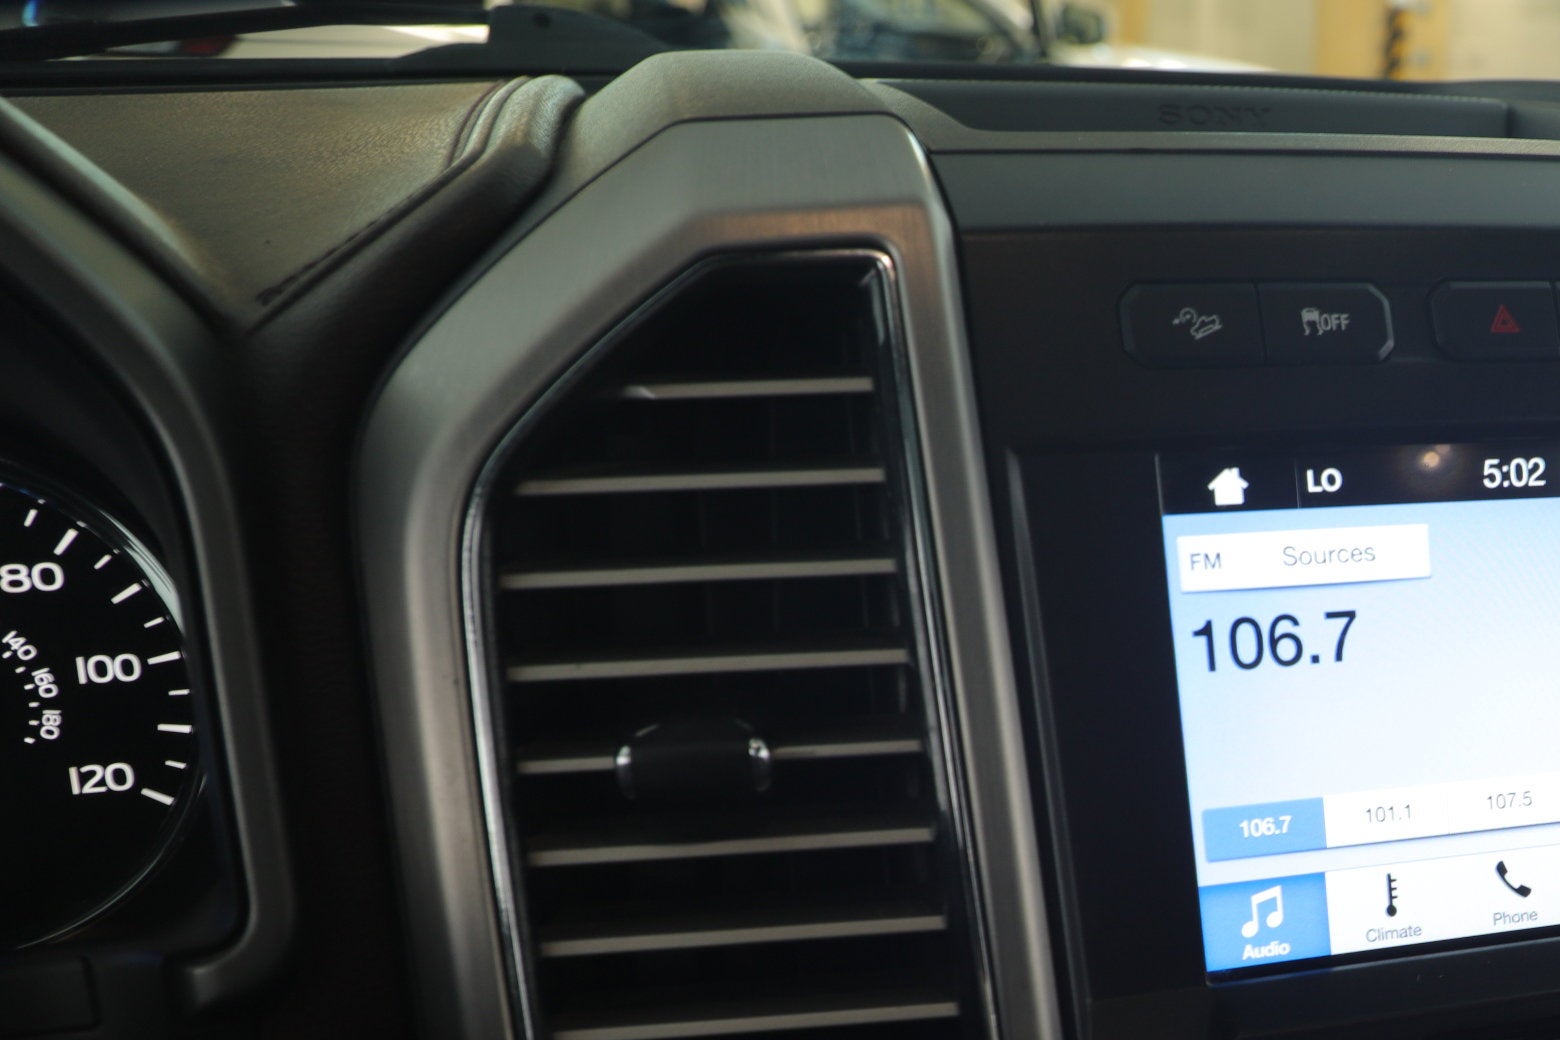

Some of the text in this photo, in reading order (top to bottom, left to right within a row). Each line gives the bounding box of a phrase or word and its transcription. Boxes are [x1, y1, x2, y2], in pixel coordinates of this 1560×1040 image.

[1157, 104, 1271, 127] SONY
[1321, 313, 1350, 331] OFF
[1306, 467, 1343, 495] LO
[1482, 456, 1547, 489] 5:02
[1190, 551, 1223, 573] FM
[1282, 542, 1376, 567] Sources
[1, 630, 38, 661] 140
[1191, 610, 1358, 673] 106.7
[75, 653, 142, 685] 100
[31, 668, 59, 699] 160
[39, 709, 62, 740] 180
[68, 762, 135, 796] 120
[1486, 791, 1533, 811] 107.5
[1365, 803, 1413, 824] 101.1
[1239, 814, 1292, 838] 106.7
[1492, 907, 1539, 926] Phone
[1365, 922, 1423, 942] Climate
[1242, 940, 1291, 960] Audio
